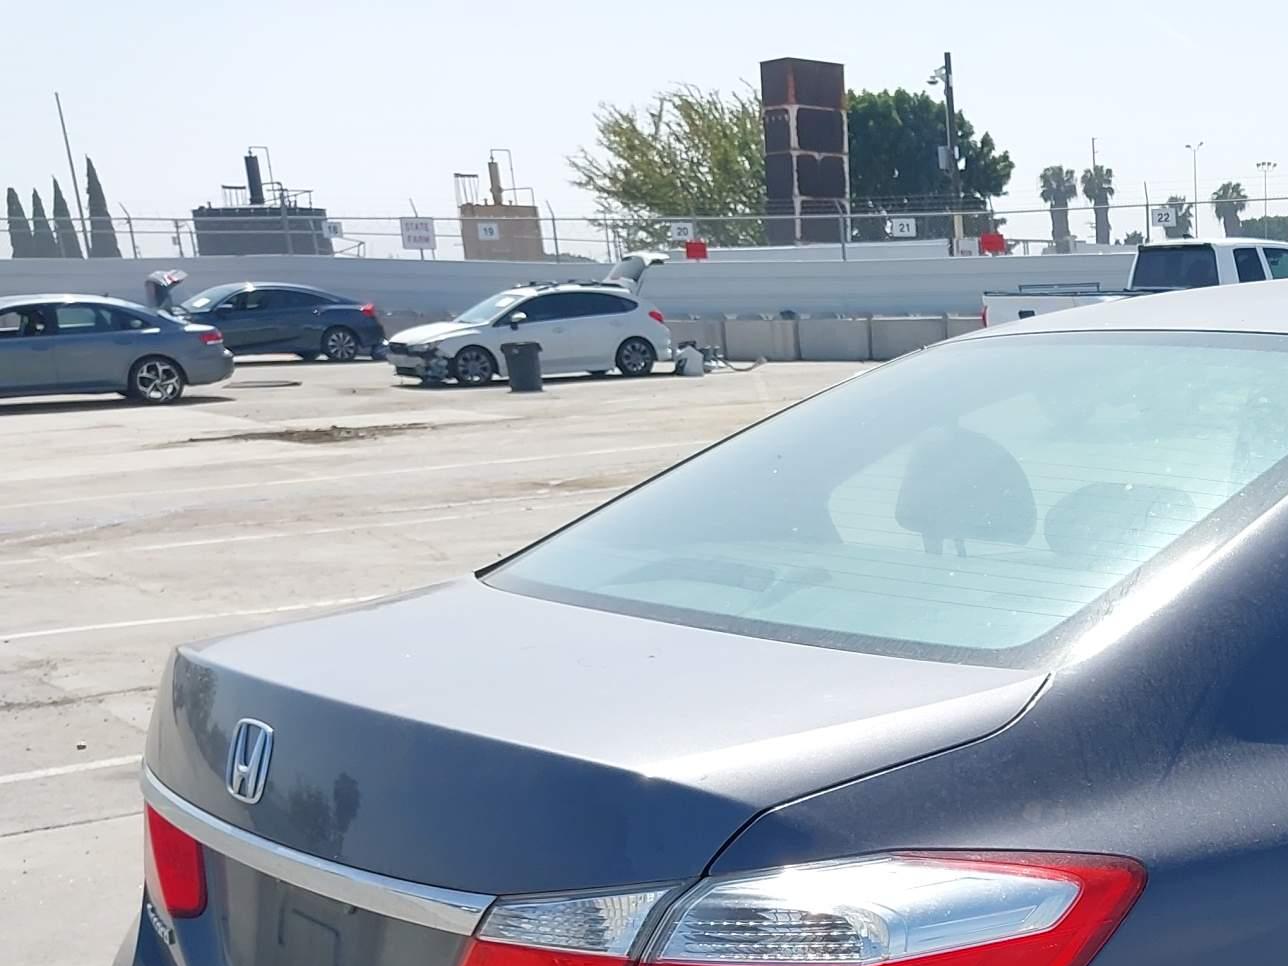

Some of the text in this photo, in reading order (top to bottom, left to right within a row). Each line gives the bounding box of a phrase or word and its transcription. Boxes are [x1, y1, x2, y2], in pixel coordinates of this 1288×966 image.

[1157, 212, 1170, 223] 22
[483, 226, 495, 236] 19
[676, 226, 688, 237] 20
[899, 223, 910, 232] 21
